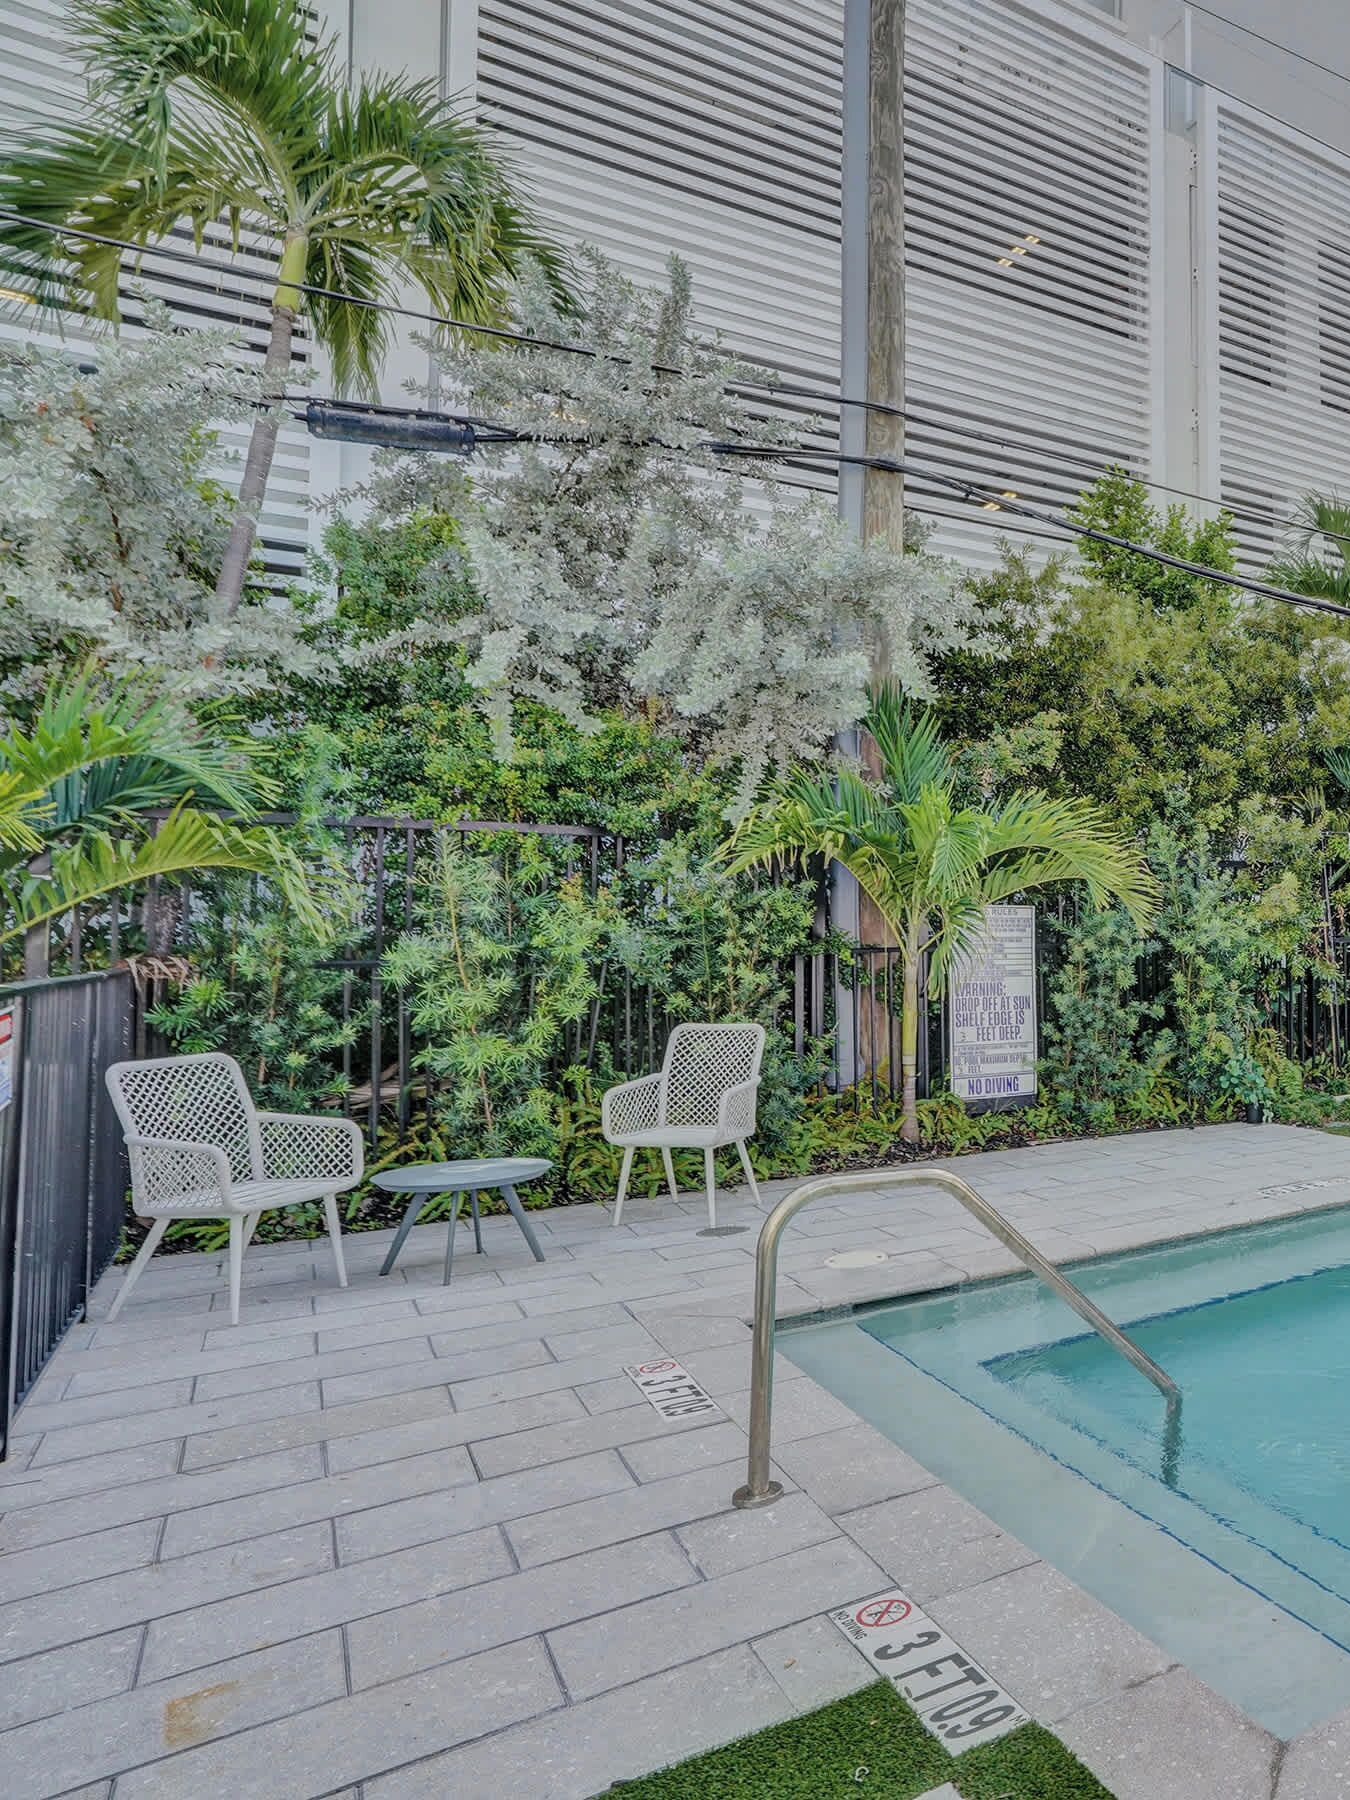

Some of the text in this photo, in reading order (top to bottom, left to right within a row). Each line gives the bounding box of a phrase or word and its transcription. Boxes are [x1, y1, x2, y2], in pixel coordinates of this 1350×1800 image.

[955, 982, 1006, 997] WARNING:
[955, 995, 1031, 1012] DROP OFF AT SUN
[955, 1010, 1025, 1028] SHELF EDGE IS
[976, 1027, 996, 1041] FEET
[999, 1025, 1021, 1041] DEEP.
[968, 1076, 1019, 1095] NO DIVING
[641, 1375, 687, 1387] 3
[832, 1610, 867, 1640] NO DIVING
[873, 1631, 941, 1660] 3
